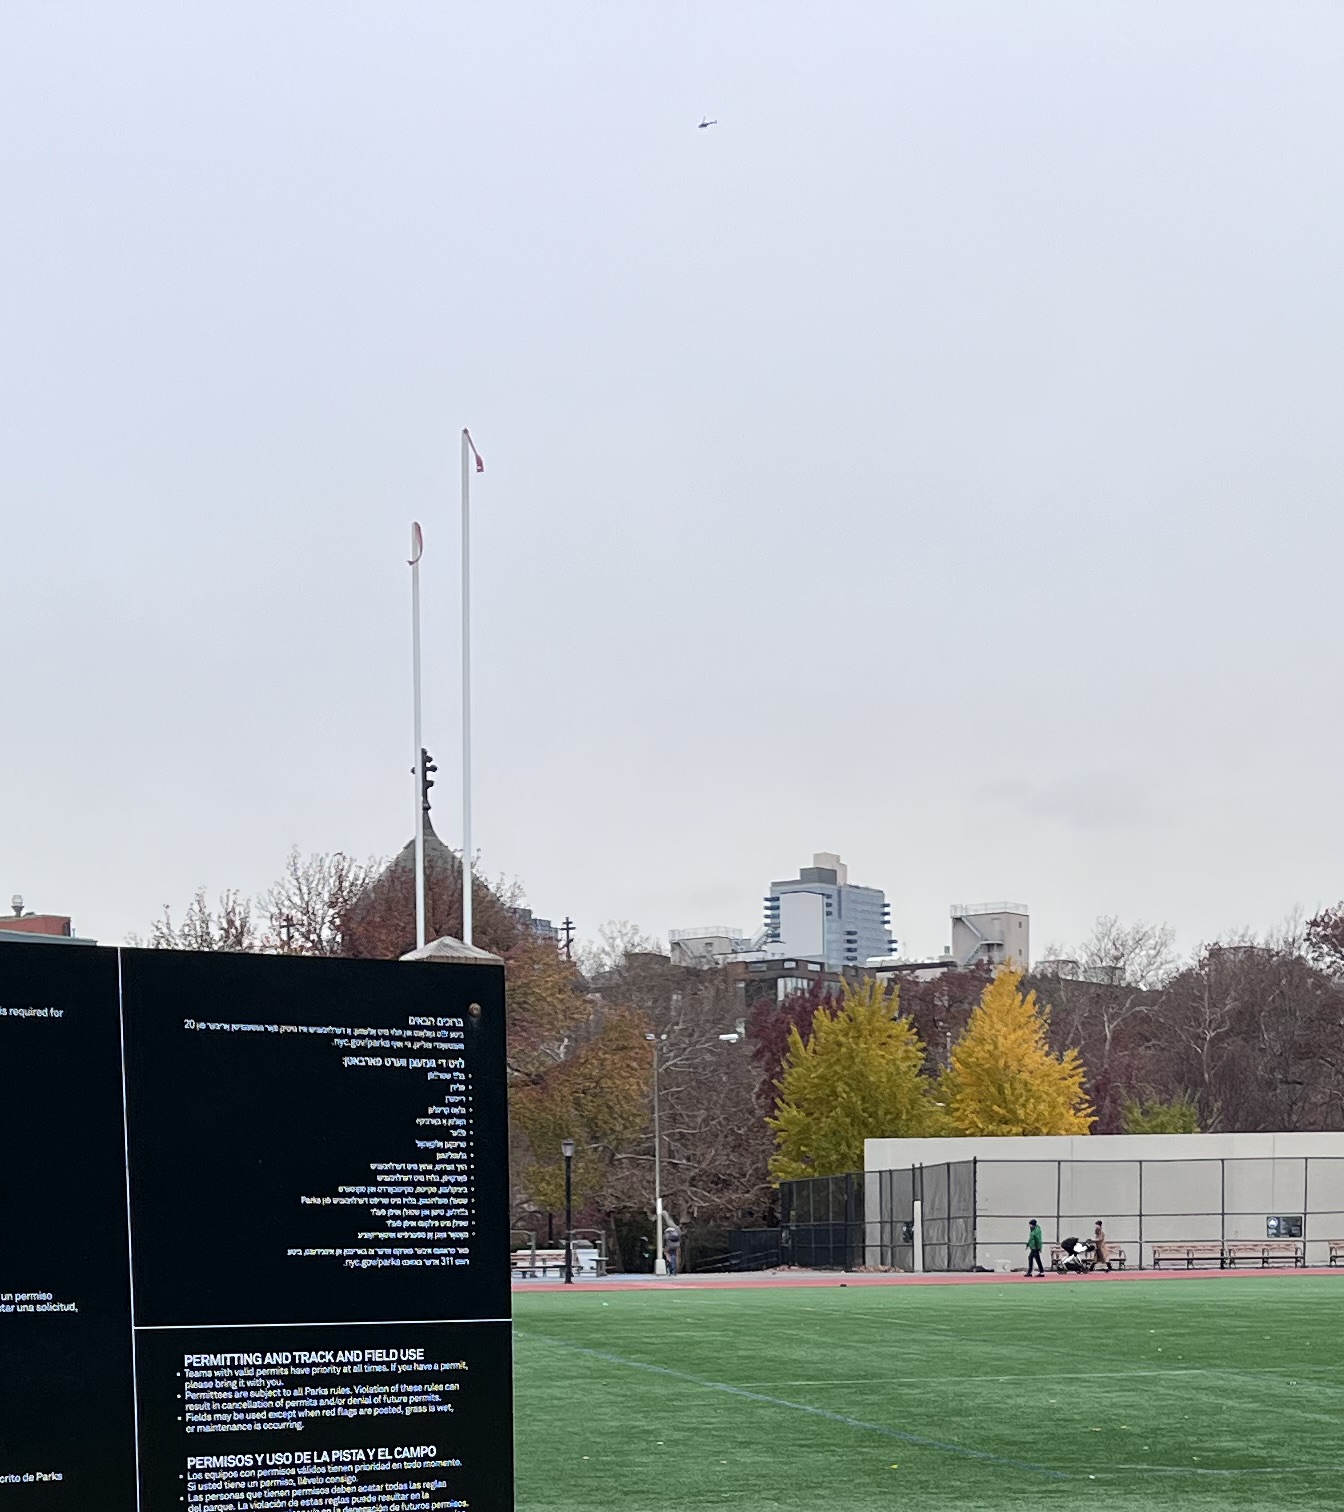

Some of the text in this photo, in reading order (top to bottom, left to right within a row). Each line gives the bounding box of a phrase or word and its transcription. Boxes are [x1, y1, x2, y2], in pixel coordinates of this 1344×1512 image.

[8, 1006, 49, 1019] required
[49, 1007, 64, 1018] for
[184, 1348, 425, 1367] PERMITTING AND TRACK AND FIELD USE
[186, 1445, 437, 1470] PERMISOS Y USO DE LA PISTA Y EL CAMPO
